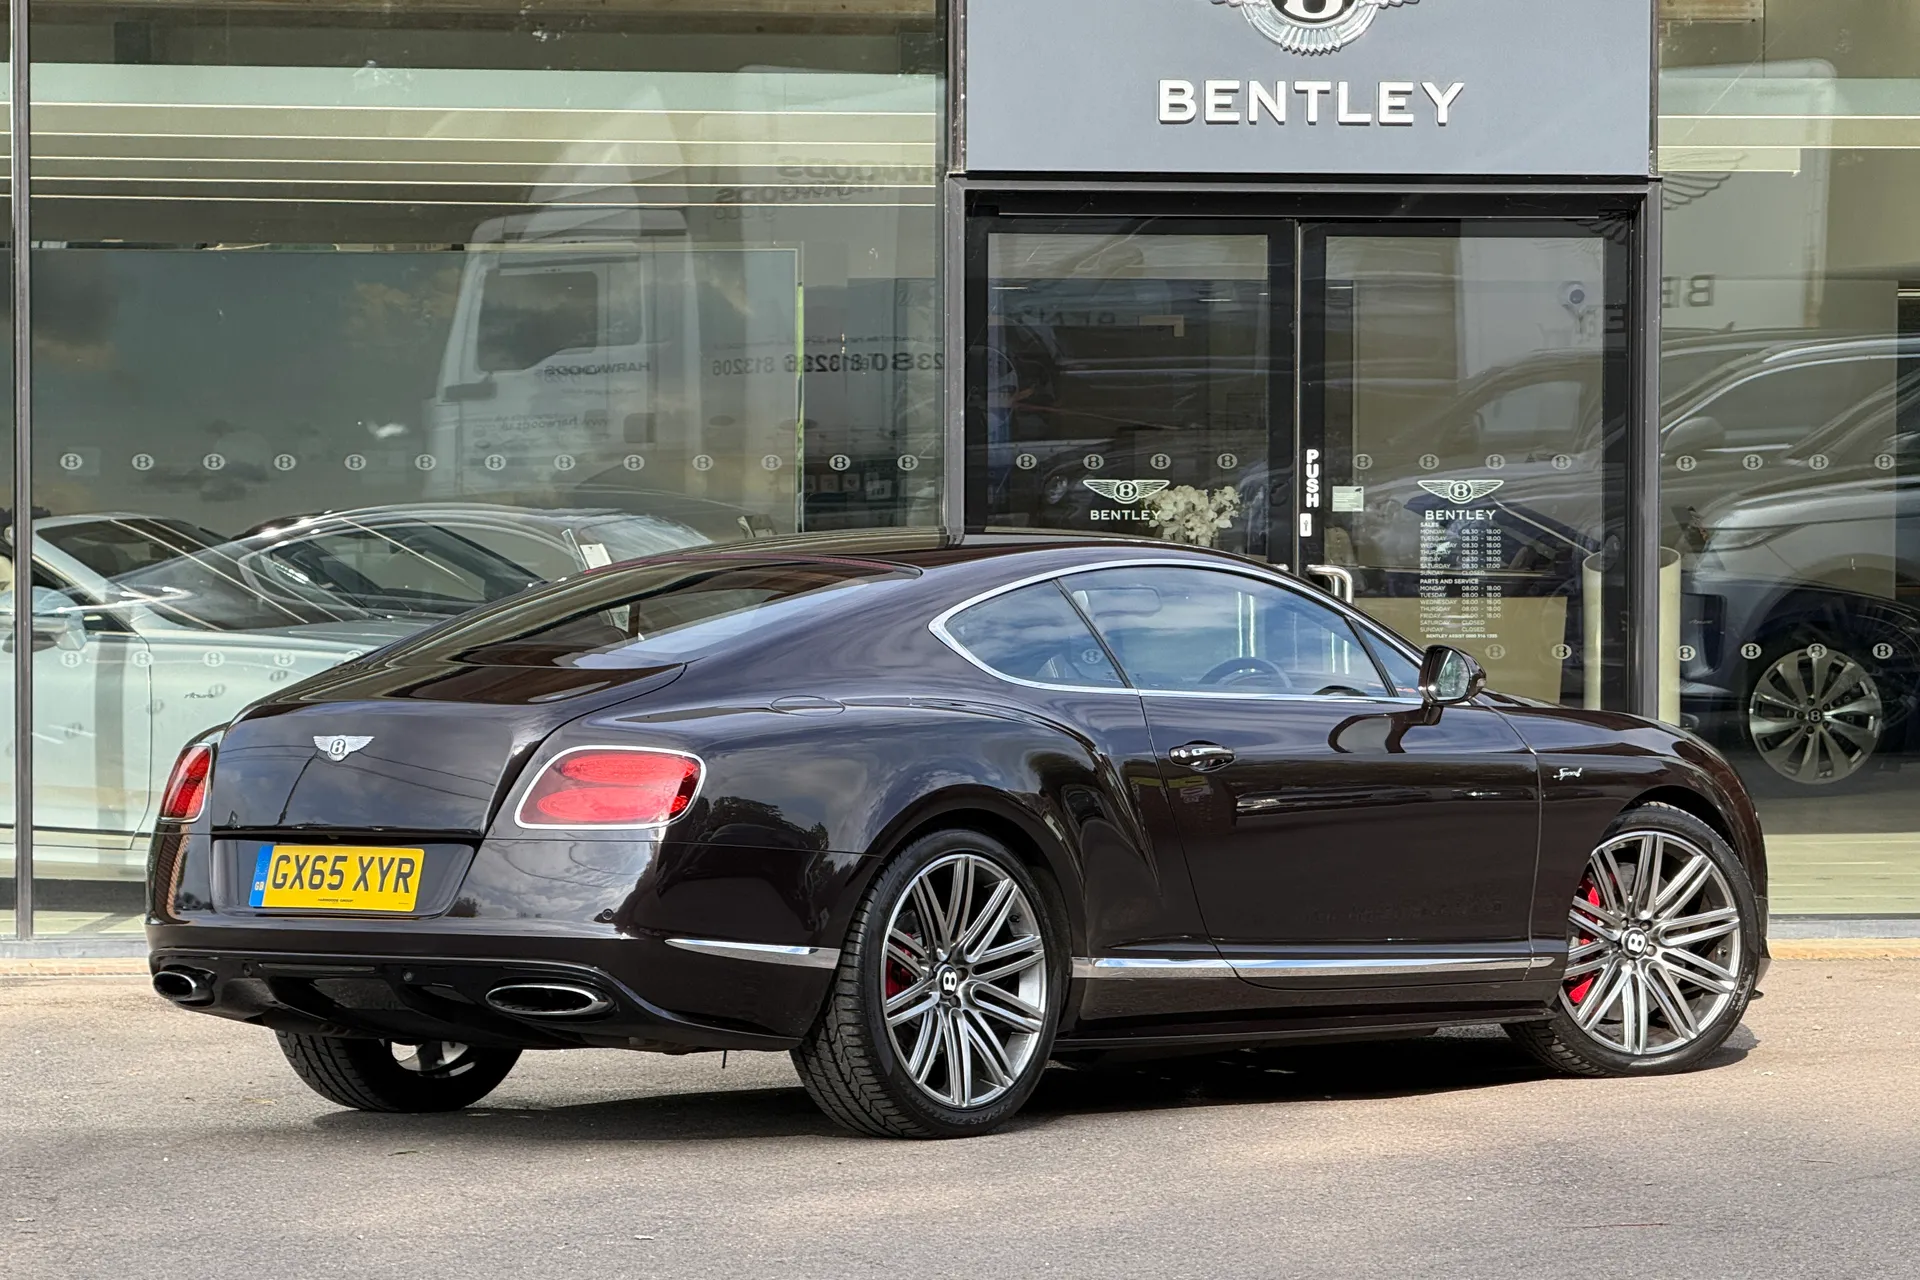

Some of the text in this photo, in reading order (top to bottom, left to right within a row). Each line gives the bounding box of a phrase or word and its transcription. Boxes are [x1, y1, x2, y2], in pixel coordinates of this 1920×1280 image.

[1158, 79, 1465, 126] BENTLEY
[1306, 449, 1319, 507] PUSH
[1090, 510, 1163, 521] BENTLEY
[1425, 509, 1497, 520] BENTLEY
[271, 854, 416, 894] GX65 XYR
